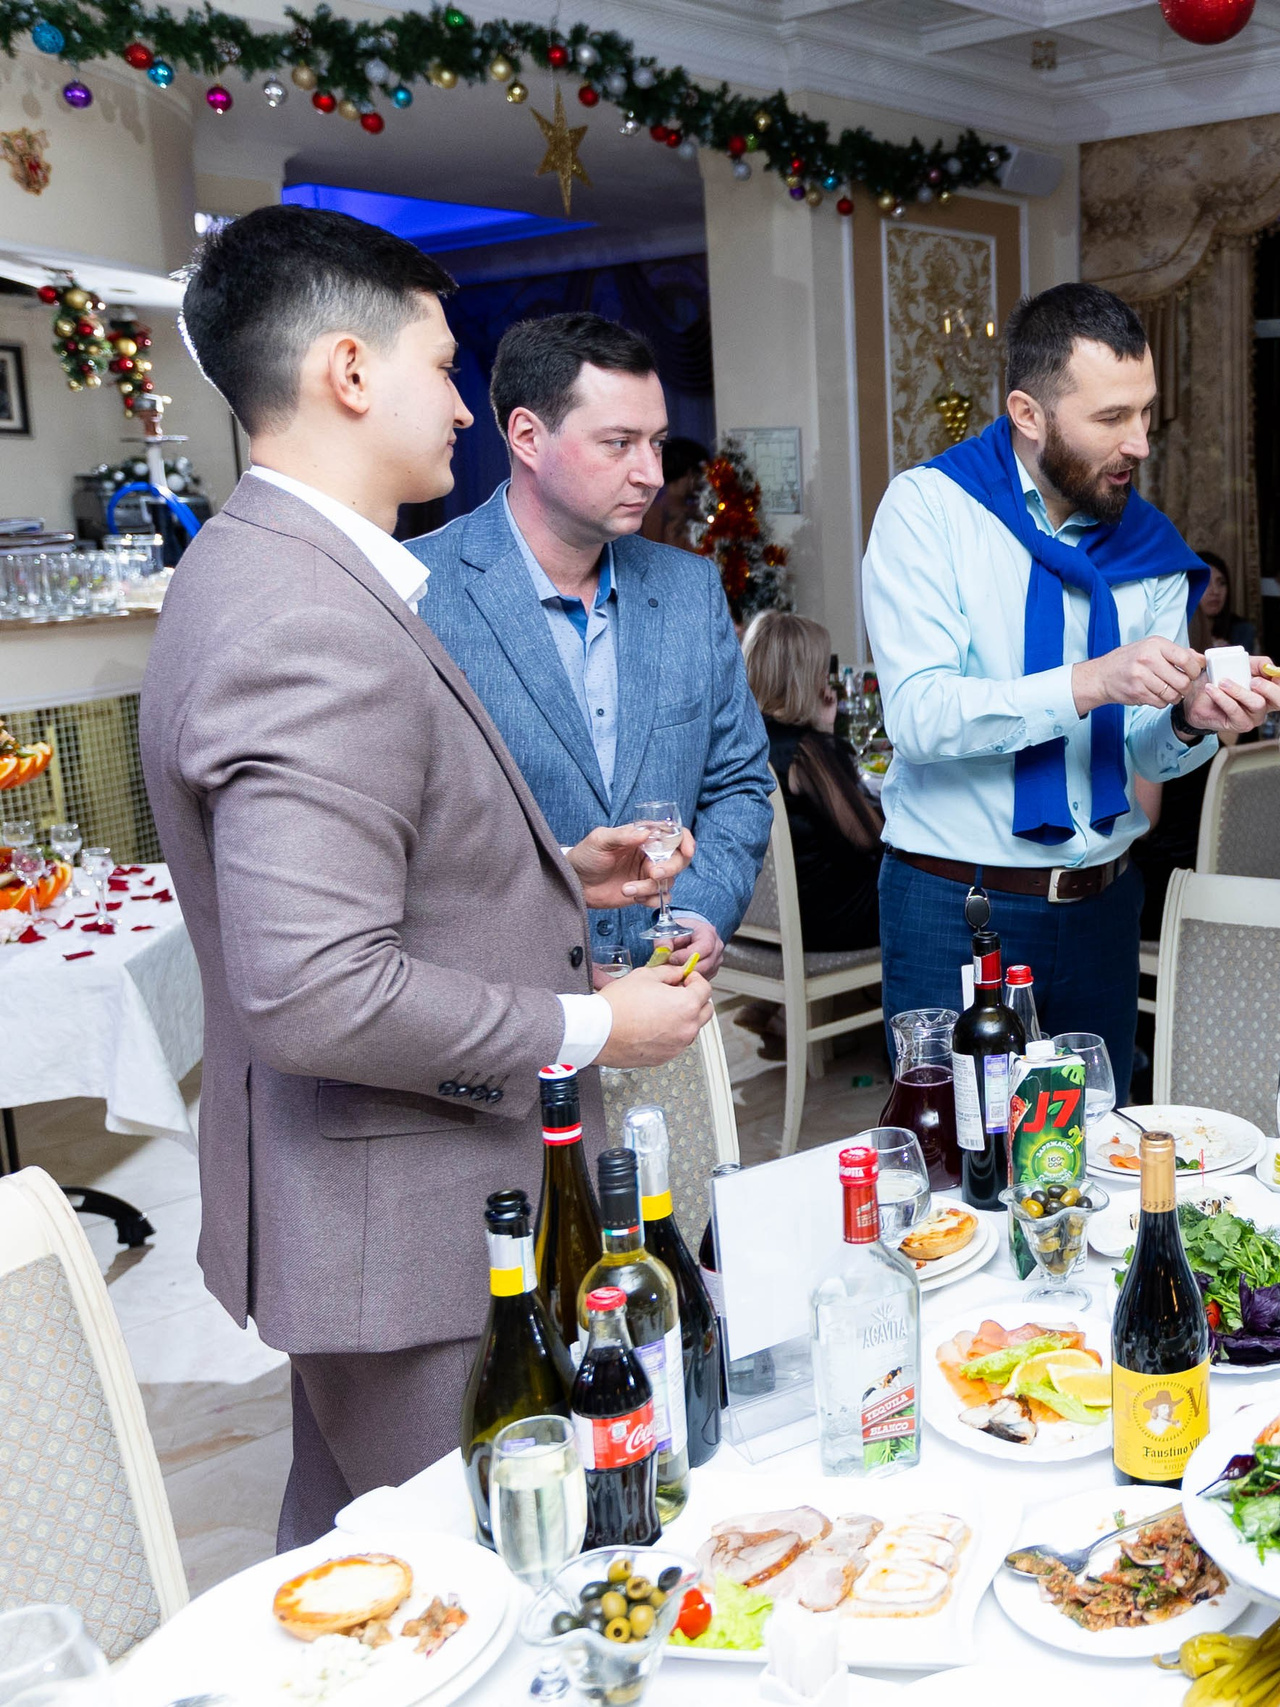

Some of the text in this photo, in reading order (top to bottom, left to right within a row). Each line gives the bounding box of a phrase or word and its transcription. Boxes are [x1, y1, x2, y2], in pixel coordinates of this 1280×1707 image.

[1023, 1089, 1081, 1133] J7
[862, 1316, 908, 1349] AGAVITA
[865, 1393, 909, 1422] TEQUILA
[870, 1421, 909, 1436] BLANCO
[1143, 1445, 1188, 1461] Faustino
